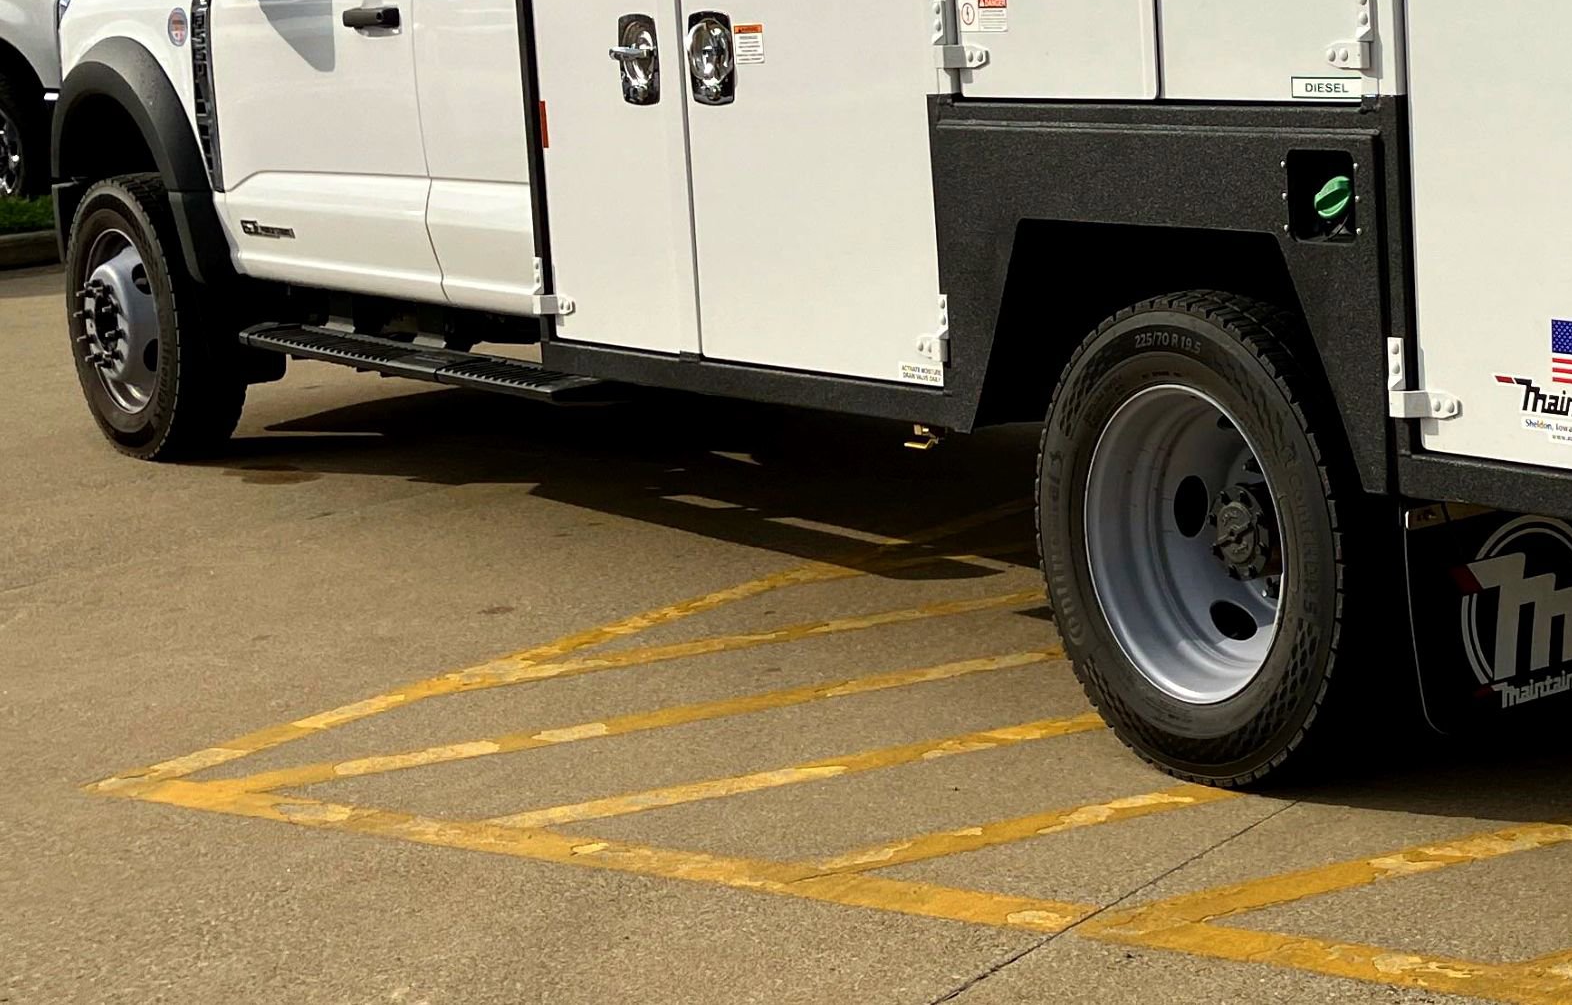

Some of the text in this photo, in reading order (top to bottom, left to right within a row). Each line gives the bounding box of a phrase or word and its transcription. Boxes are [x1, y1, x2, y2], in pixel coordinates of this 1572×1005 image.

[1305, 82, 1349, 93] DIESEL
[1135, 331, 1202, 354] 225/70 R 19.5
[1525, 419, 1554, 431] Sheldon,
[1556, 423, 1572, 433] Iowa
